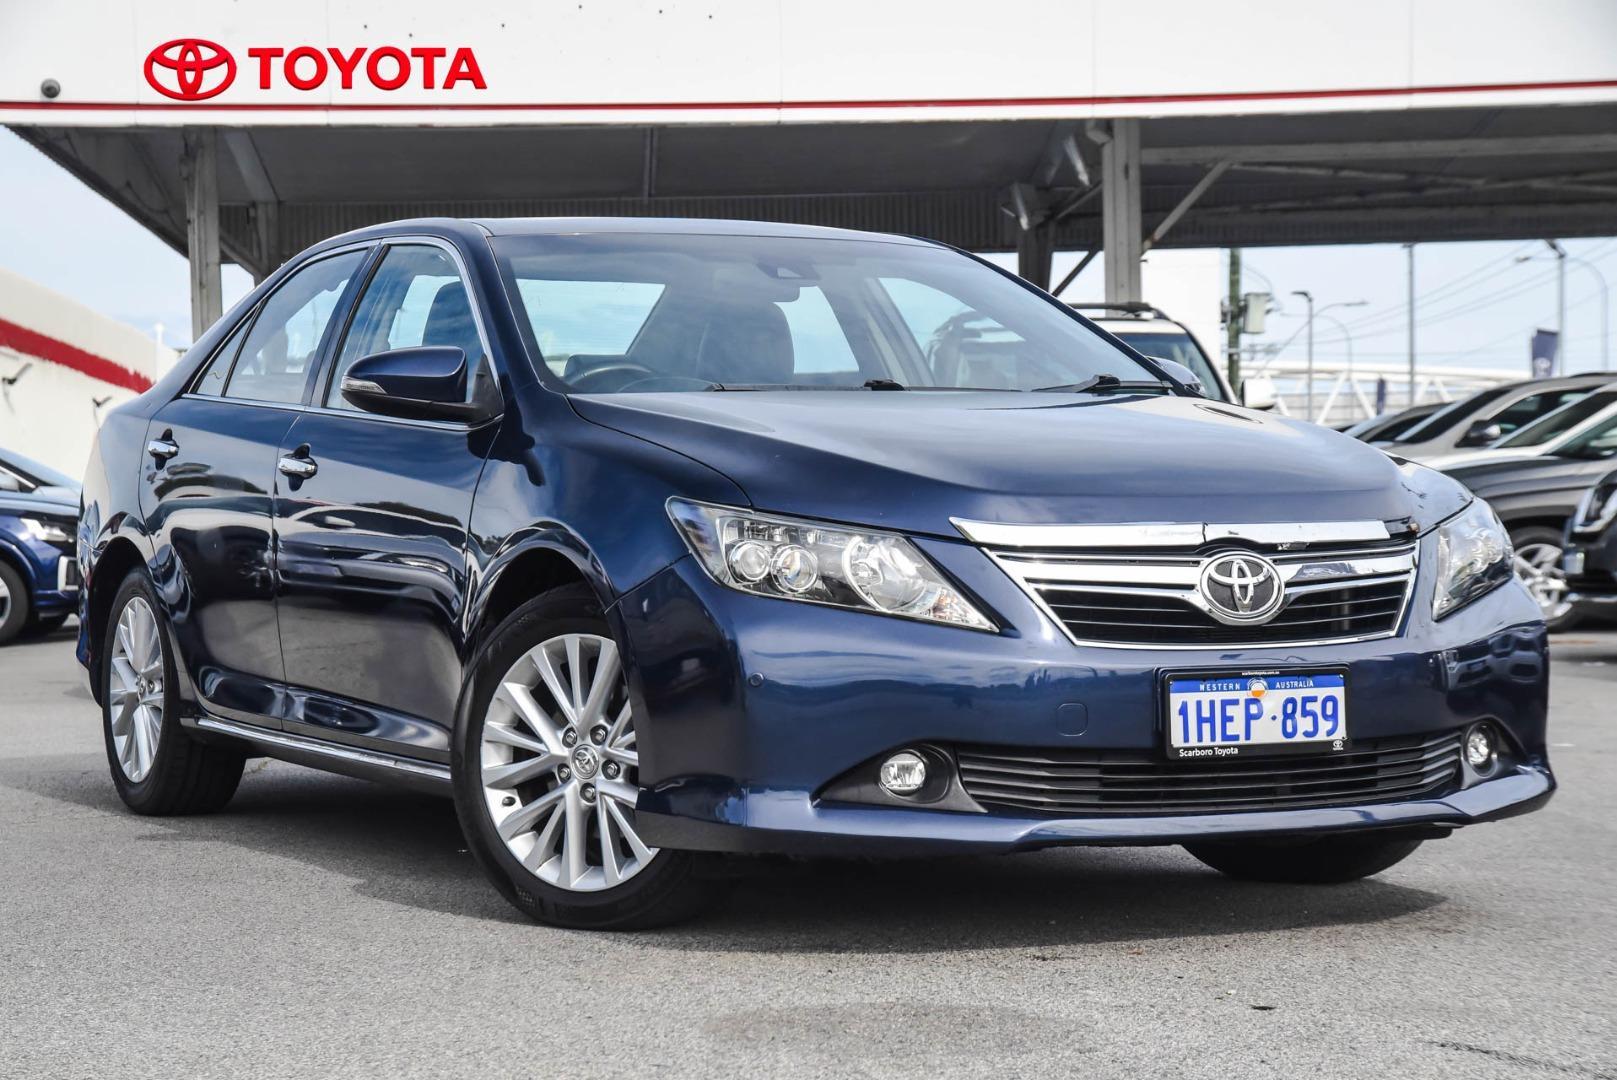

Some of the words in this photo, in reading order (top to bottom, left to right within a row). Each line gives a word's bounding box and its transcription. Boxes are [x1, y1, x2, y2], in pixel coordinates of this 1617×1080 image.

[248, 46, 487, 90] TOYOTA
[1199, 683, 1241, 692] WESTERN
[1275, 680, 1314, 689] AUSTRALIA
[1179, 748, 1213, 757] Scarboro
[1214, 746, 1239, 756] Toyota
